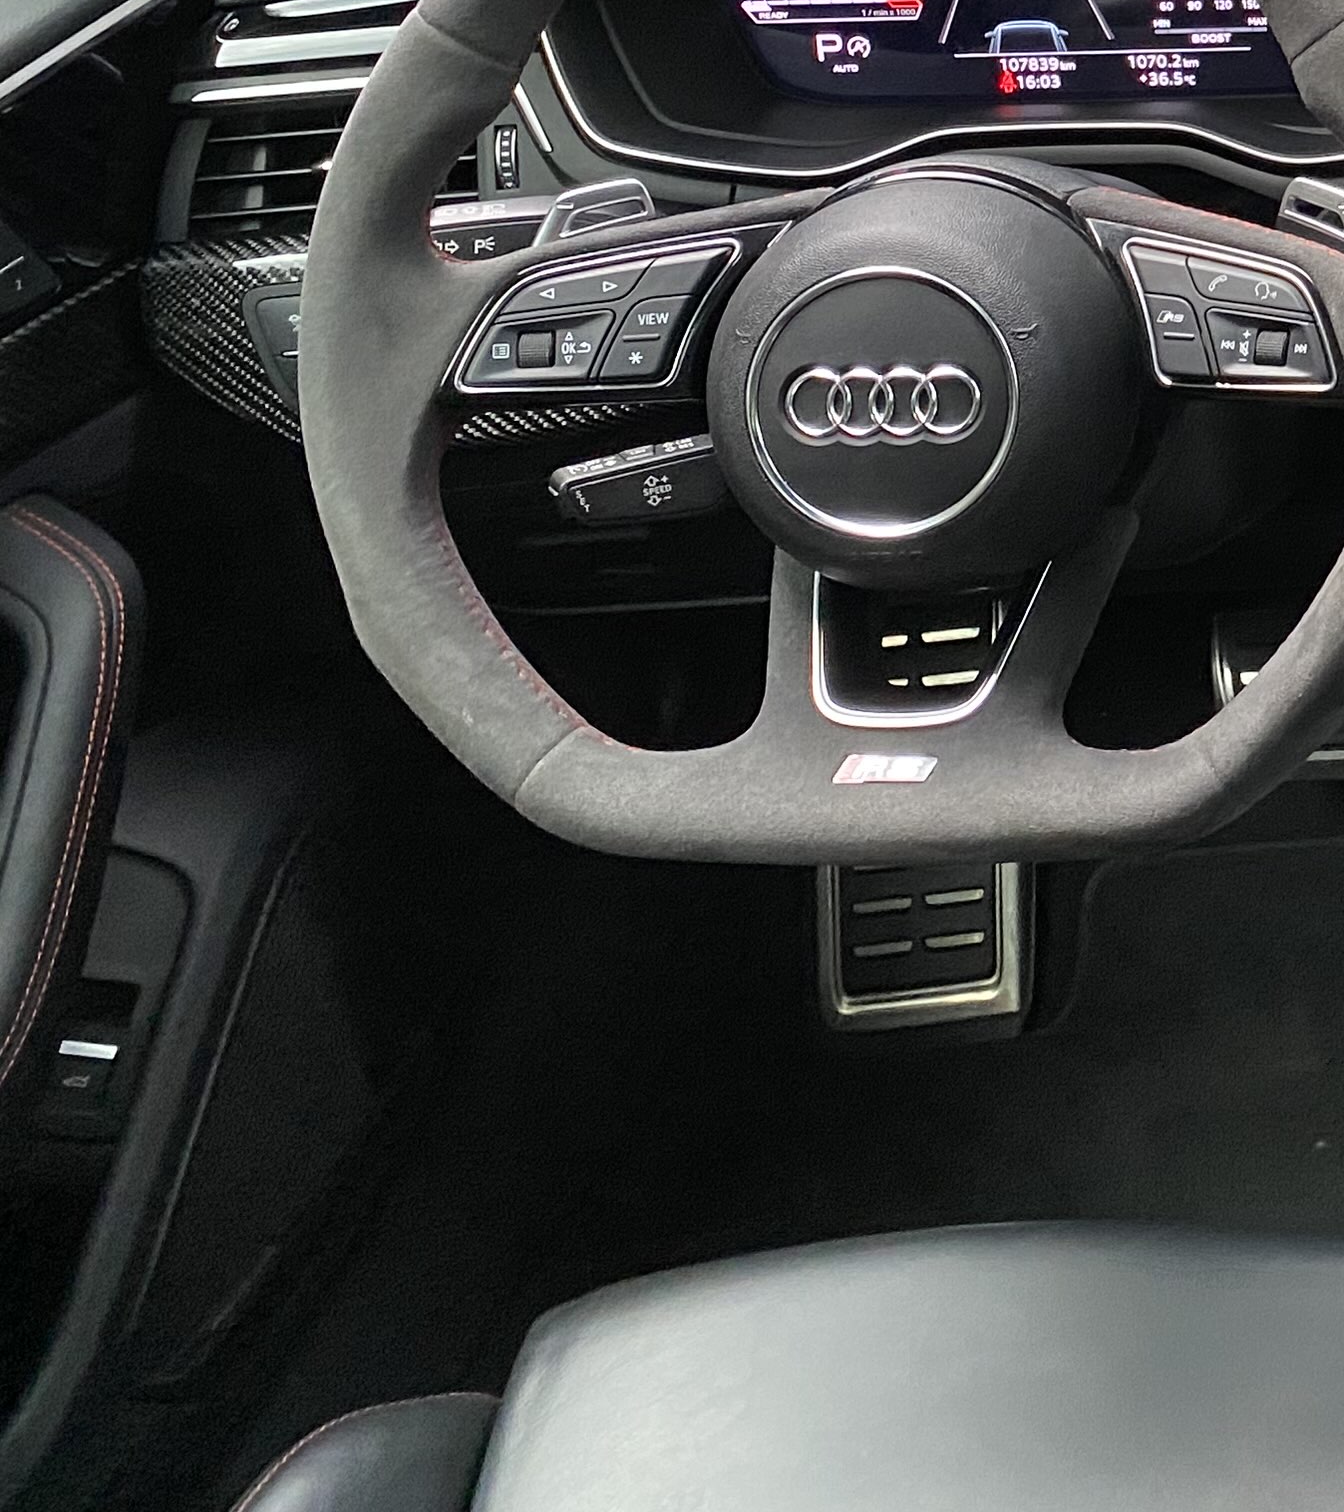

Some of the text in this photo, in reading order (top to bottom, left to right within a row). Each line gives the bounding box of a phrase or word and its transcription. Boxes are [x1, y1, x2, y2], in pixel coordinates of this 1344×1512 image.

[1159, 1, 1174, 12] 60
[1213, 0, 1233, 11] 120
[815, 34, 843, 62] P
[832, 64, 859, 74] AUTO
[1016, 75, 1061, 89] 16:03
[637, 312, 669, 325] VIEW
[561, 342, 576, 355] OK
[642, 484, 673, 497] SPEED
[574, 489, 591, 513] SET
